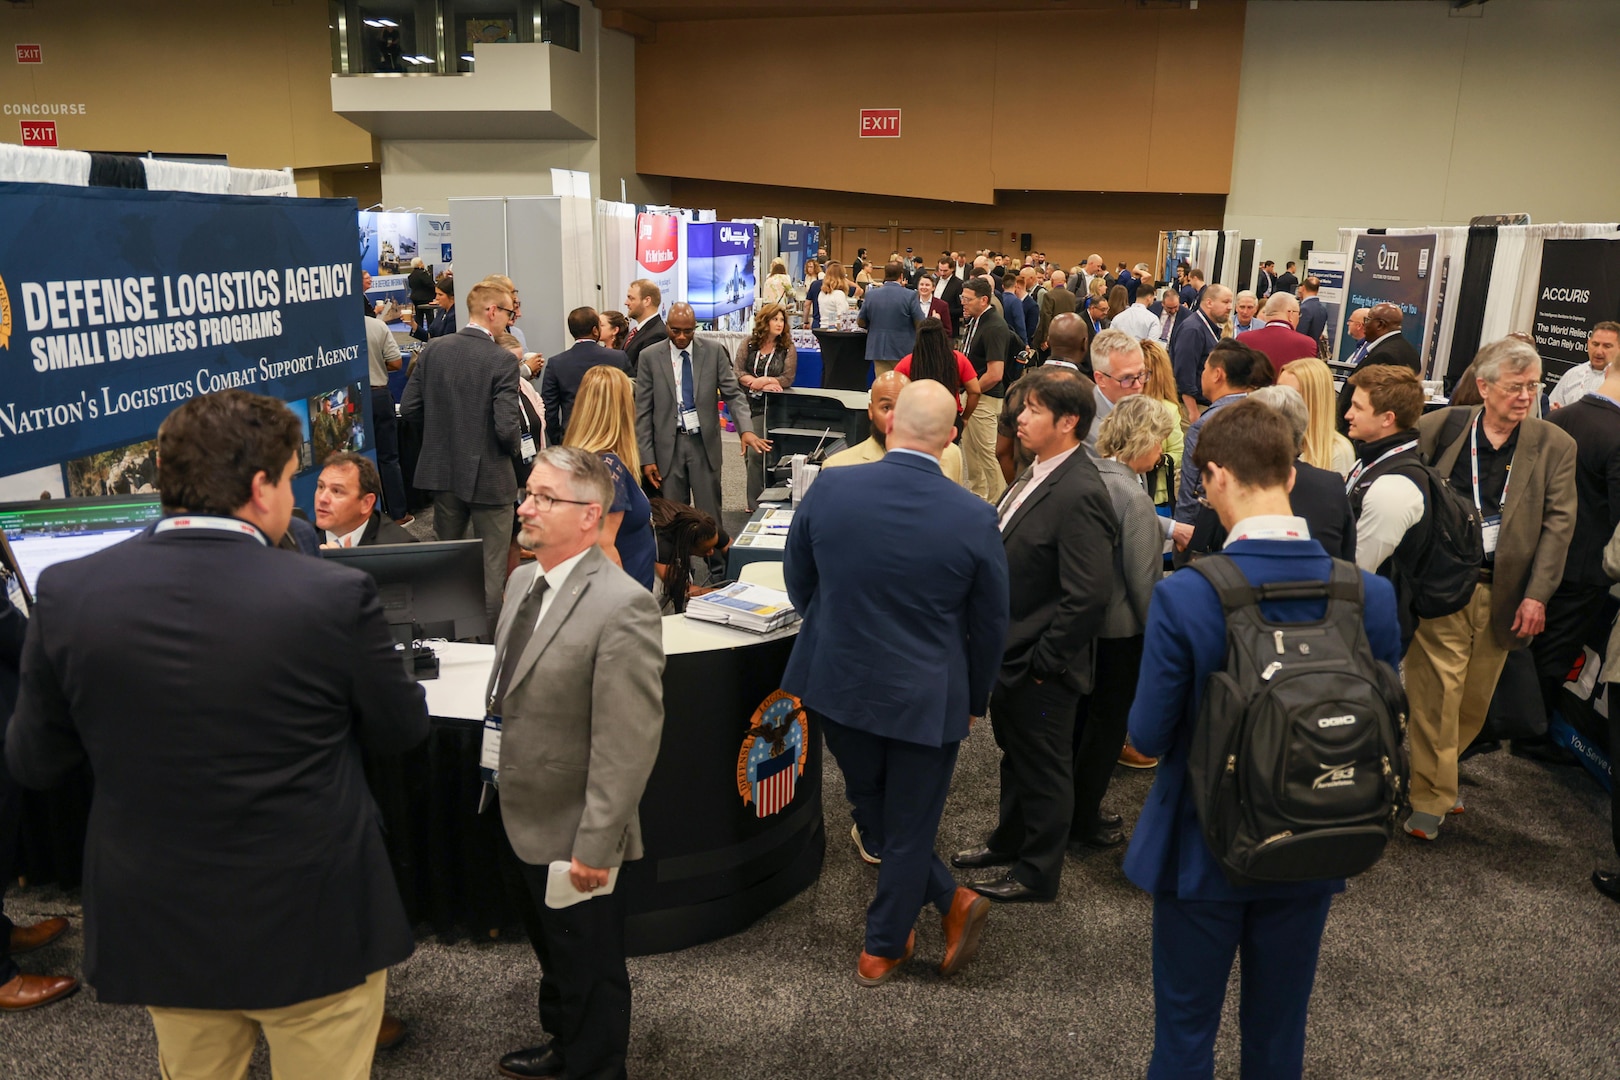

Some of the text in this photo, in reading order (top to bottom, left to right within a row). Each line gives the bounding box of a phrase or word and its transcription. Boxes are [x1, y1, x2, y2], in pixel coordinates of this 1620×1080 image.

[18, 49, 39, 59] EXIT
[3, 103, 86, 115] CONCOURSE
[863, 116, 898, 130] EXIT
[23, 127, 54, 141] EXIT
[21, 263, 352, 332] DEFENSE LOGISTICS AGENCY
[1542, 287, 1590, 304] ACCURIS
[1409, 304, 1417, 314] You
[1537, 323, 1549, 332] The
[1550, 324, 1569, 336] World
[1569, 328, 1586, 338] Relies
[30, 310, 282, 372] SMALL BUSINESS PROGRAMS
[1536, 335, 1547, 344] You
[1547, 337, 1560, 346] Can
[1561, 339, 1574, 351] Rely
[1575, 342, 1583, 351] On
[0, 344, 359, 438] NATION'S LOGISTICS COMBAT SUPPORT AGENCY
[1318, 714, 1356, 728] OGIO
[1570, 734, 1608, 770] You Serve
[738, 742, 750, 792] DEFENSE
